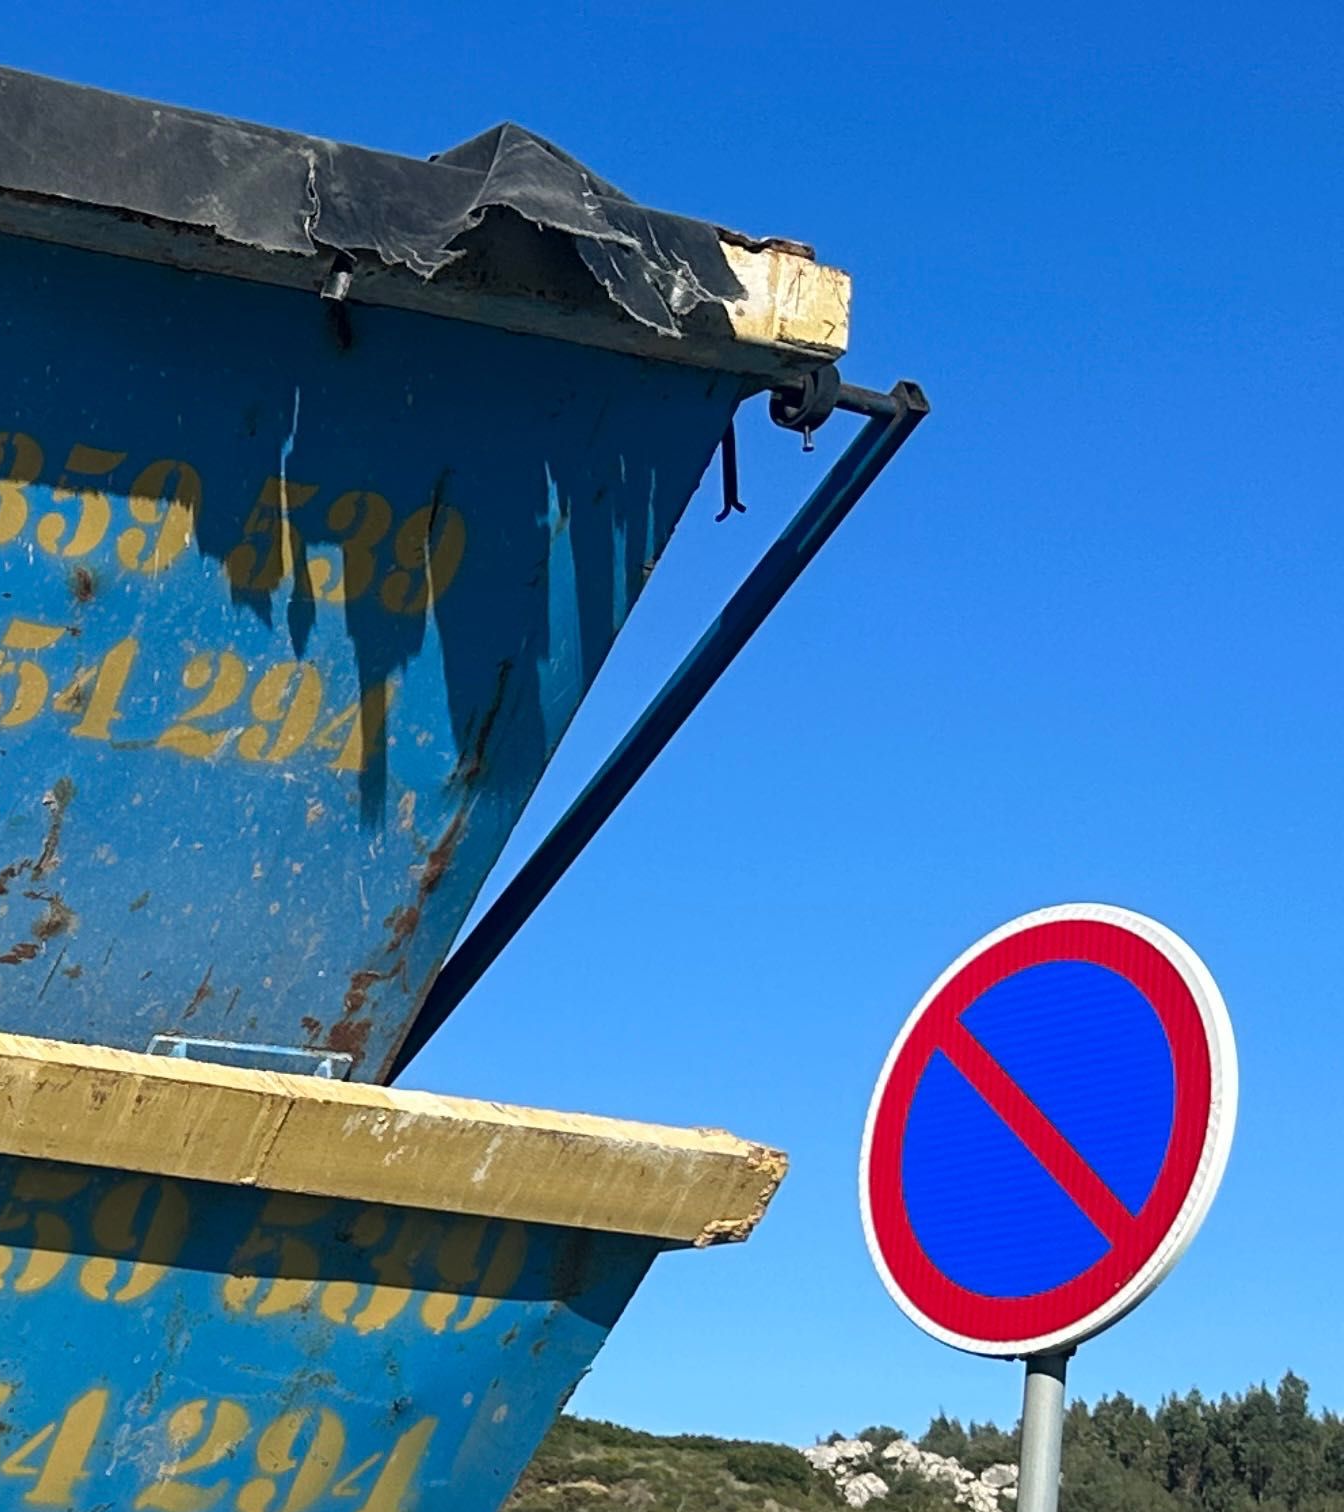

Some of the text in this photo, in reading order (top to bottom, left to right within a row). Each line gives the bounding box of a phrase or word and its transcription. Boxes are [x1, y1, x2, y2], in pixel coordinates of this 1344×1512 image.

[223, 478, 468, 613] 539
[158, 649, 396, 773] 294
[222, 1195, 530, 1337] 539
